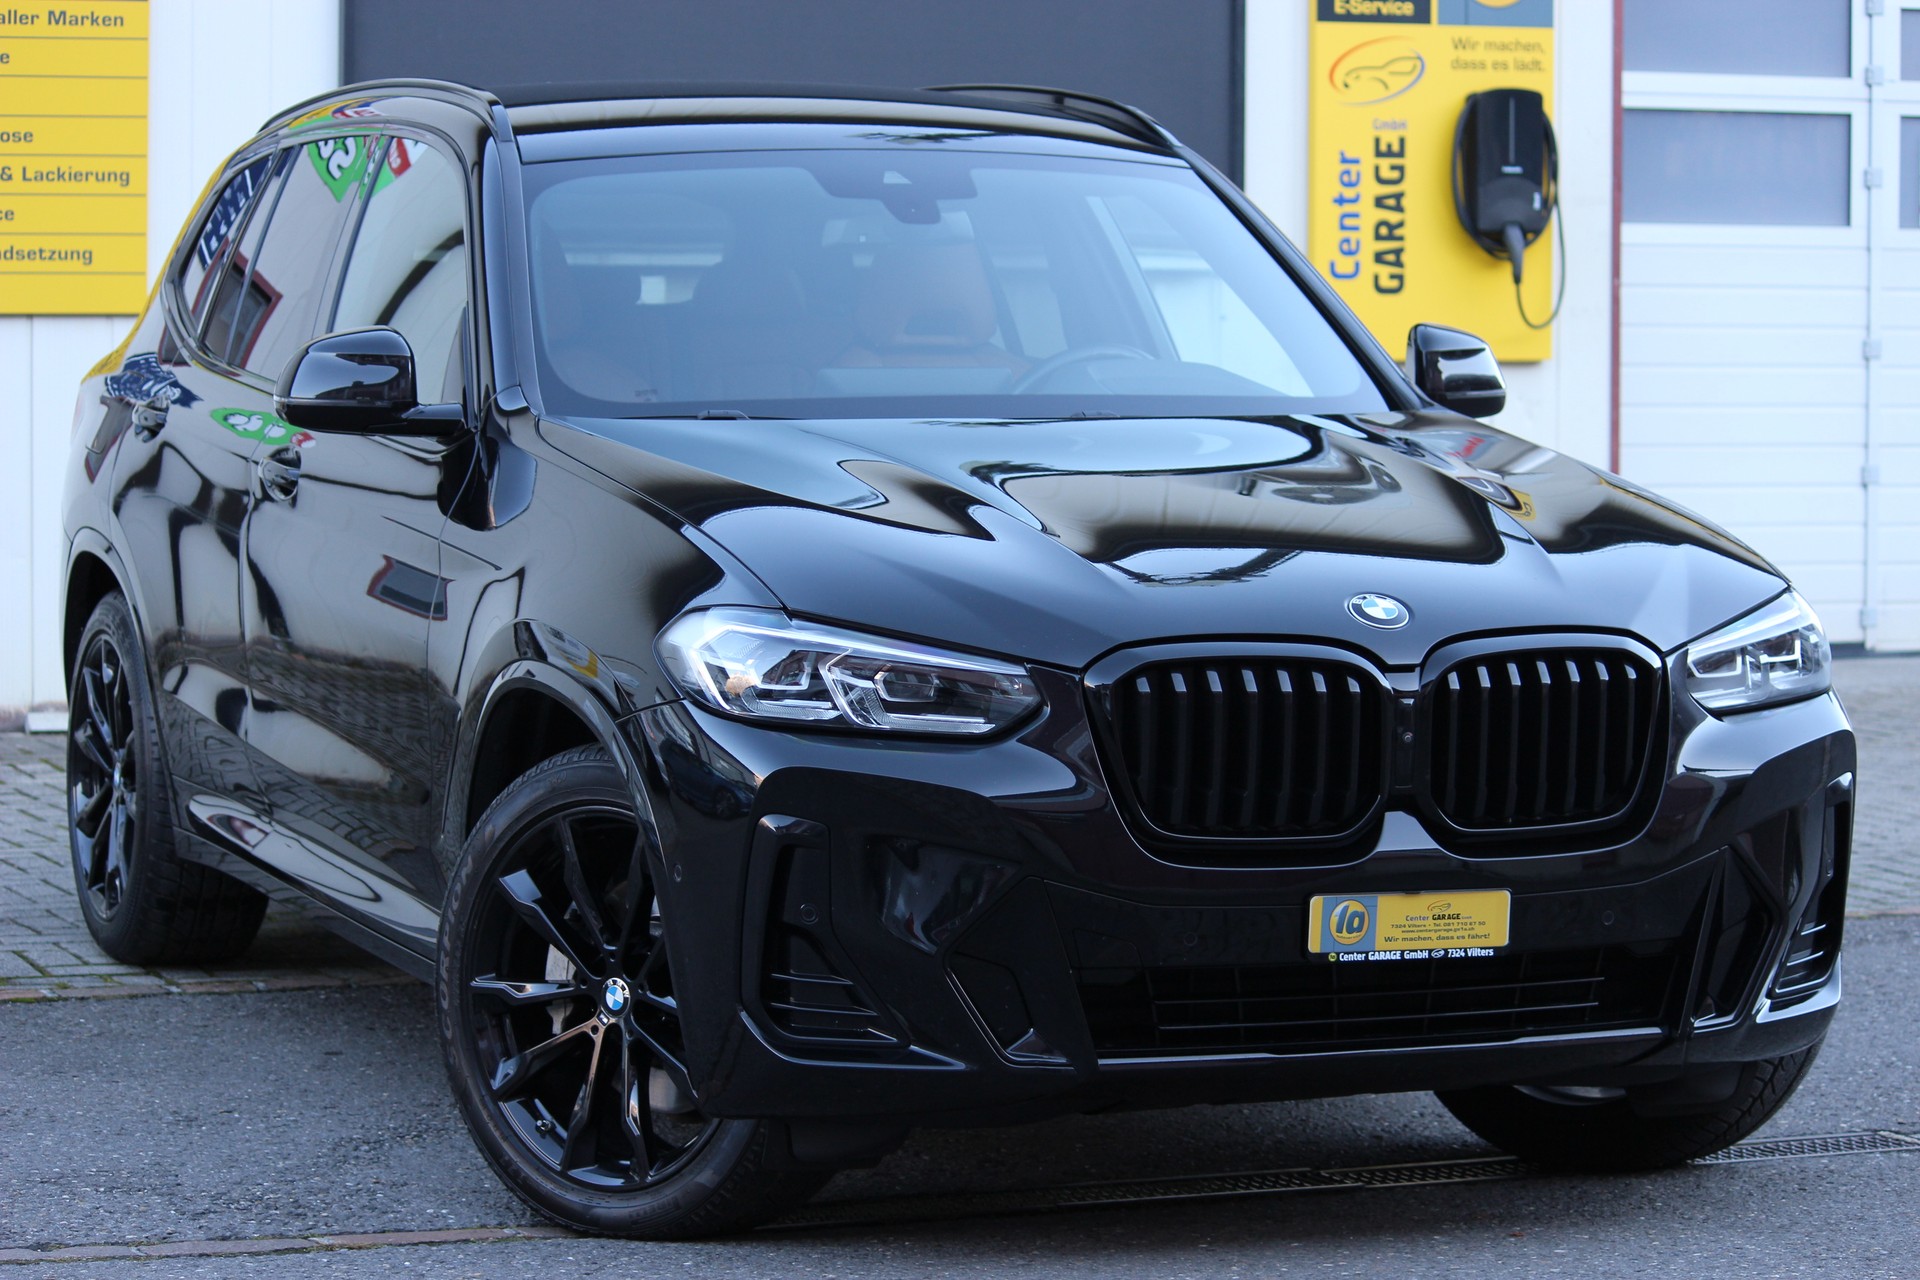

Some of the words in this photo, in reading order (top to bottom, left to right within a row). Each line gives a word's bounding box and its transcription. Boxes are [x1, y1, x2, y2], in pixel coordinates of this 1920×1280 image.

[47, 10, 124, 26] Marken
[1451, 37, 1480, 50] Wir
[1484, 38, 1544, 54] machen,
[1450, 57, 1487, 70] dass
[1491, 60, 1508, 70] es
[22, 166, 130, 187] Lackierung
[1330, 151, 1360, 280] Center
[1374, 136, 1406, 294] GARAGE
[0, 245, 93, 265] dsetzung
[1339, 952, 1366, 961] Center
[1368, 951, 1401, 960] GARAGE
[1404, 950, 1428, 960] GmbH
[1448, 949, 1465, 958] 7324
[1467, 948, 1494, 957] Vilters
